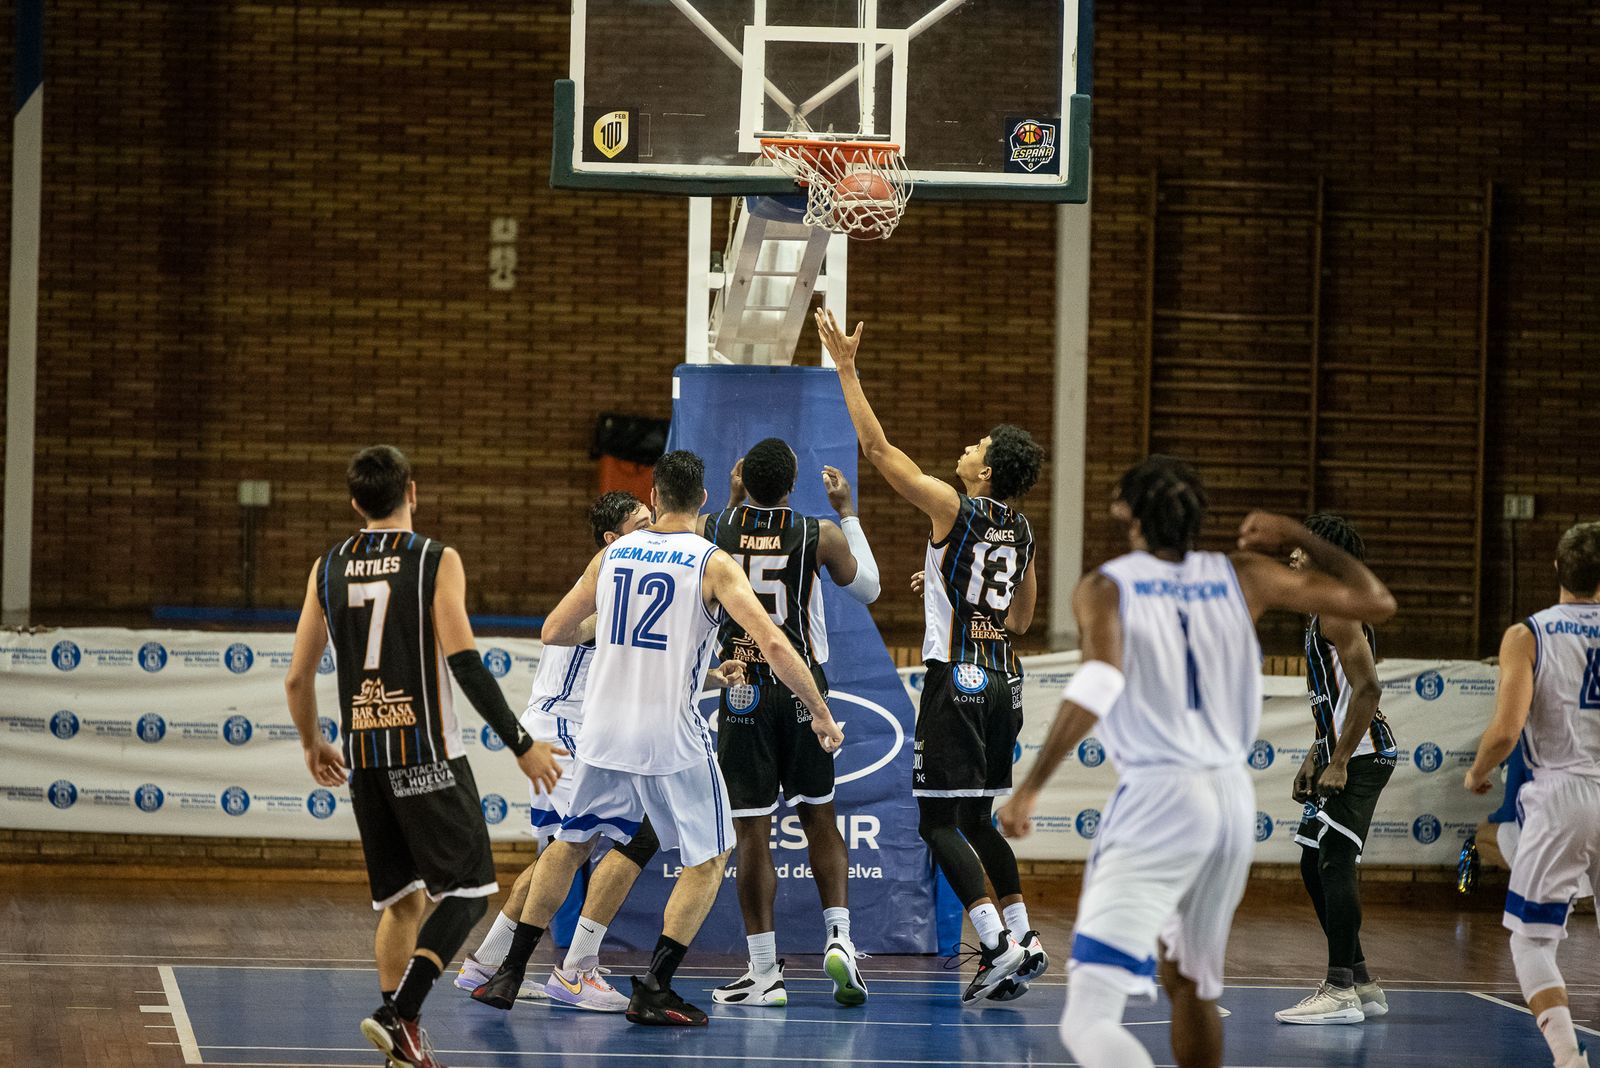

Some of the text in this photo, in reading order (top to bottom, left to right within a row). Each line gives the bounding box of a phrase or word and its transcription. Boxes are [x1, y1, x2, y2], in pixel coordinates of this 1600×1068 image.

[600, 122, 622, 149] 100
[1013, 147, 1053, 158] ESPAÑA
[740, 535, 781, 550] FADIKA
[609, 547, 668, 563] CHEMARI
[344, 556, 401, 577] ARTILES
[966, 541, 1018, 611] 13
[730, 554, 790, 626] 5
[610, 567, 676, 651] 12
[347, 580, 391, 670] 7
[953, 695, 985, 704] AONES
[352, 703, 414, 719] BAR CASA
[352, 716, 417, 730] HERMANDAD
[725, 716, 755, 725] AONES
[391, 779, 403, 791] DE
[408, 769, 455, 787] HUELVA
[663, 864, 683, 878] La
[793, 864, 813, 879] de
